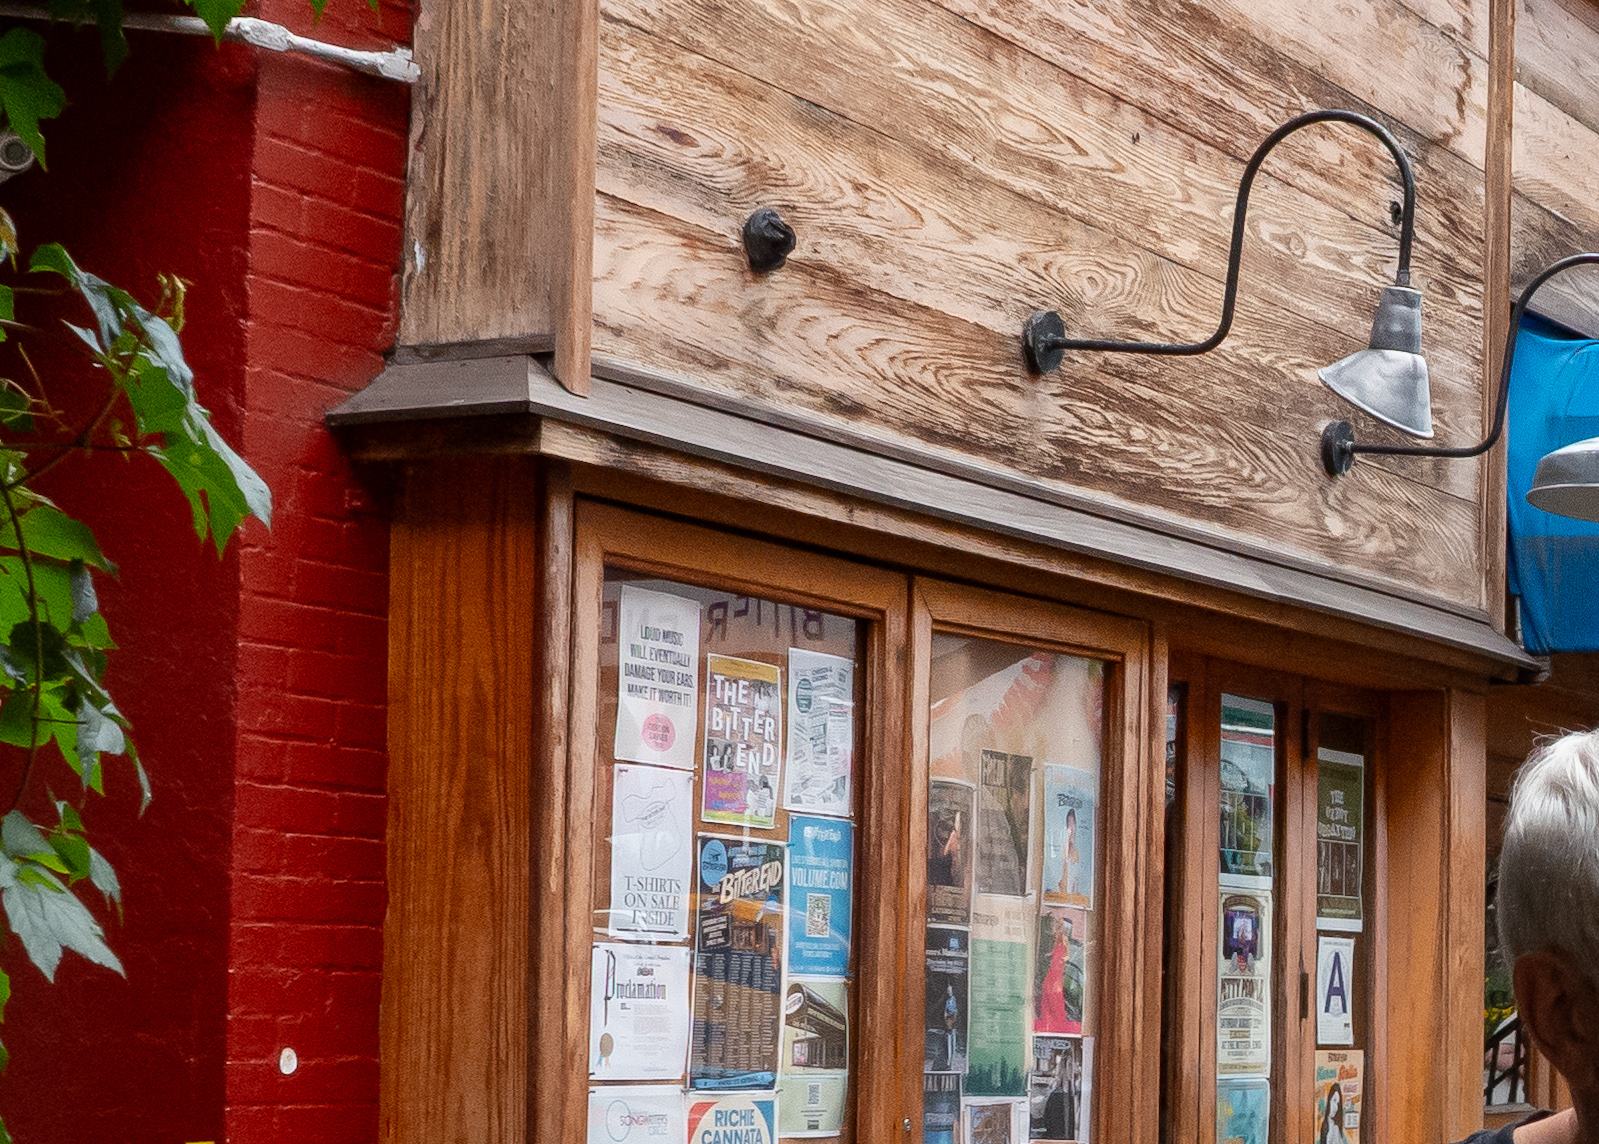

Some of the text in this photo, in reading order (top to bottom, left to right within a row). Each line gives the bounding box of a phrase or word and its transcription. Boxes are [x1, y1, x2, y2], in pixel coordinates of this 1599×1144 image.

[640, 624, 661, 641] LOUD
[631, 643, 691, 667] WILL EVENTUALLY
[625, 662, 655, 681] DAMAGE
[657, 668, 676, 685] YOUR
[627, 683, 649, 700] MAKE
[650, 687, 657, 701] IT
[713, 674, 749, 706] THE
[711, 706, 775, 741] BITTER
[736, 742, 774, 775] END
[624, 875, 682, 894] T-SHIRTS
[719, 861, 783, 904] BITTER END
[624, 893, 680, 911] ON SALE
[631, 910, 675, 926] INSIDE
[1323, 951, 1348, 1013] A
[714, 1109, 755, 1127] RICHIE
